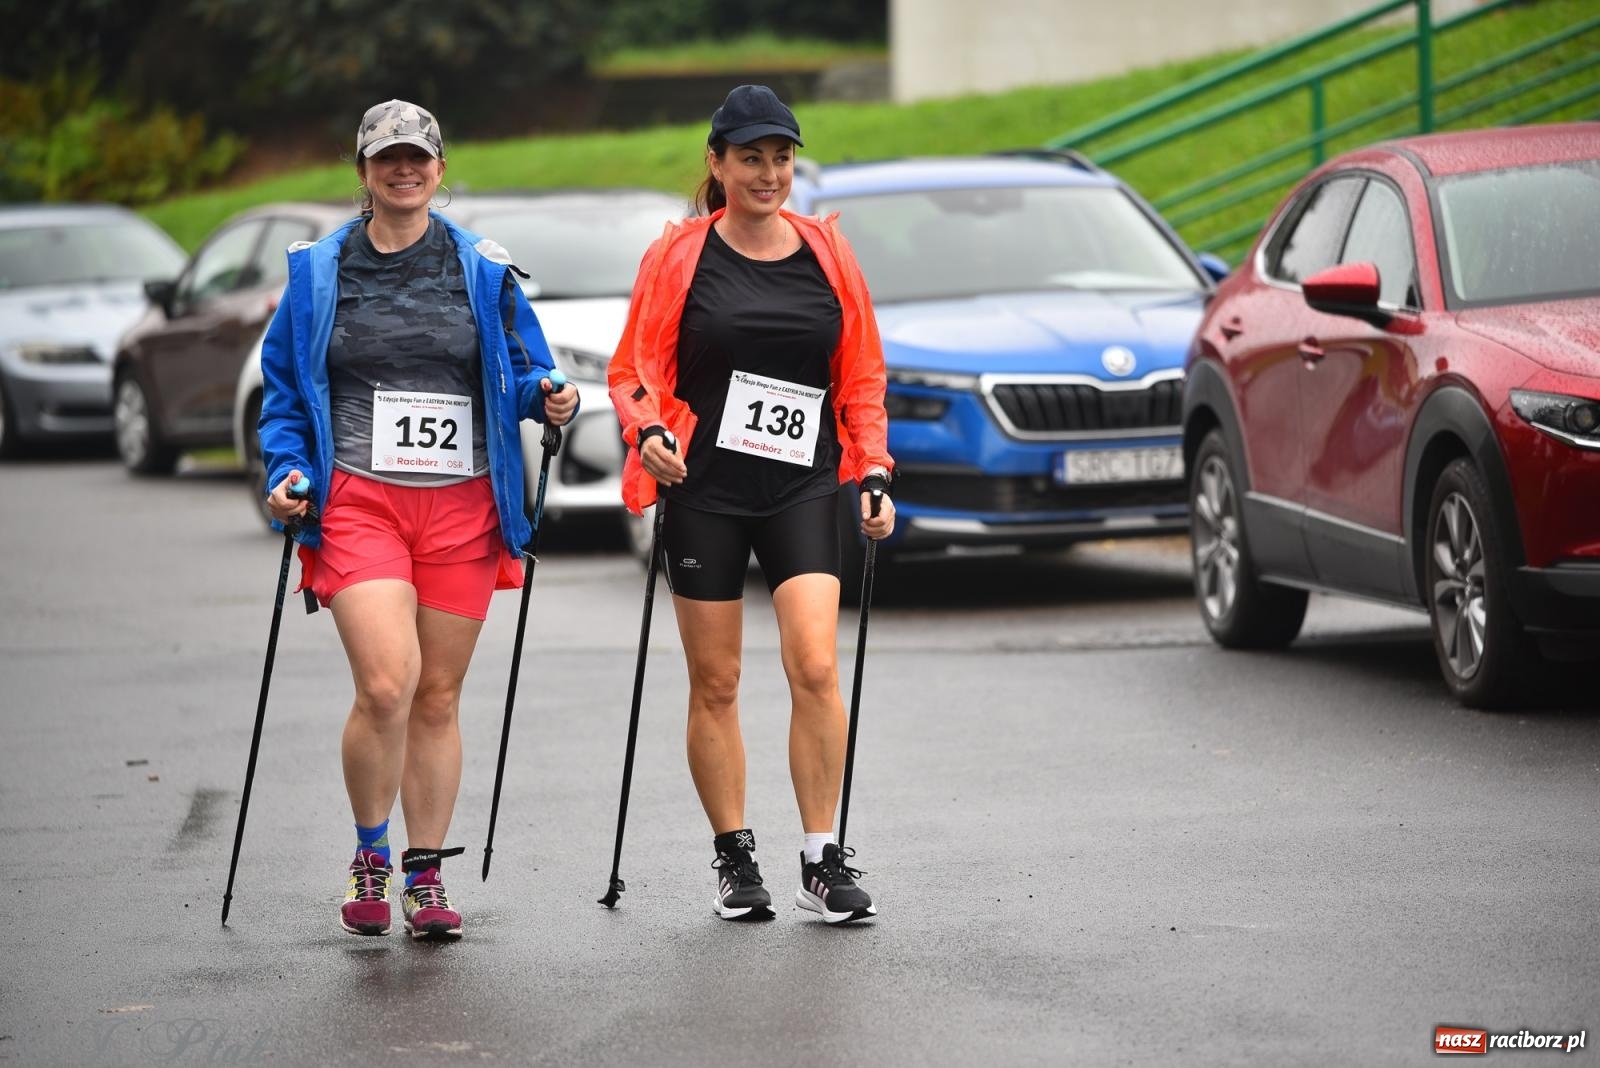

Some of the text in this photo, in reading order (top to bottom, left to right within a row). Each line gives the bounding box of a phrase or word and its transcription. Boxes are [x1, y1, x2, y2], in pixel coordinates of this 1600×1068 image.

[770, 383, 779, 391] Fun
[383, 396, 398, 404] Edycja
[400, 396, 413, 404] Biegu
[745, 400, 805, 440] 138
[395, 416, 458, 451] 152
[742, 439, 782, 455] Racibórz
[397, 457, 439, 467] Racibórz
